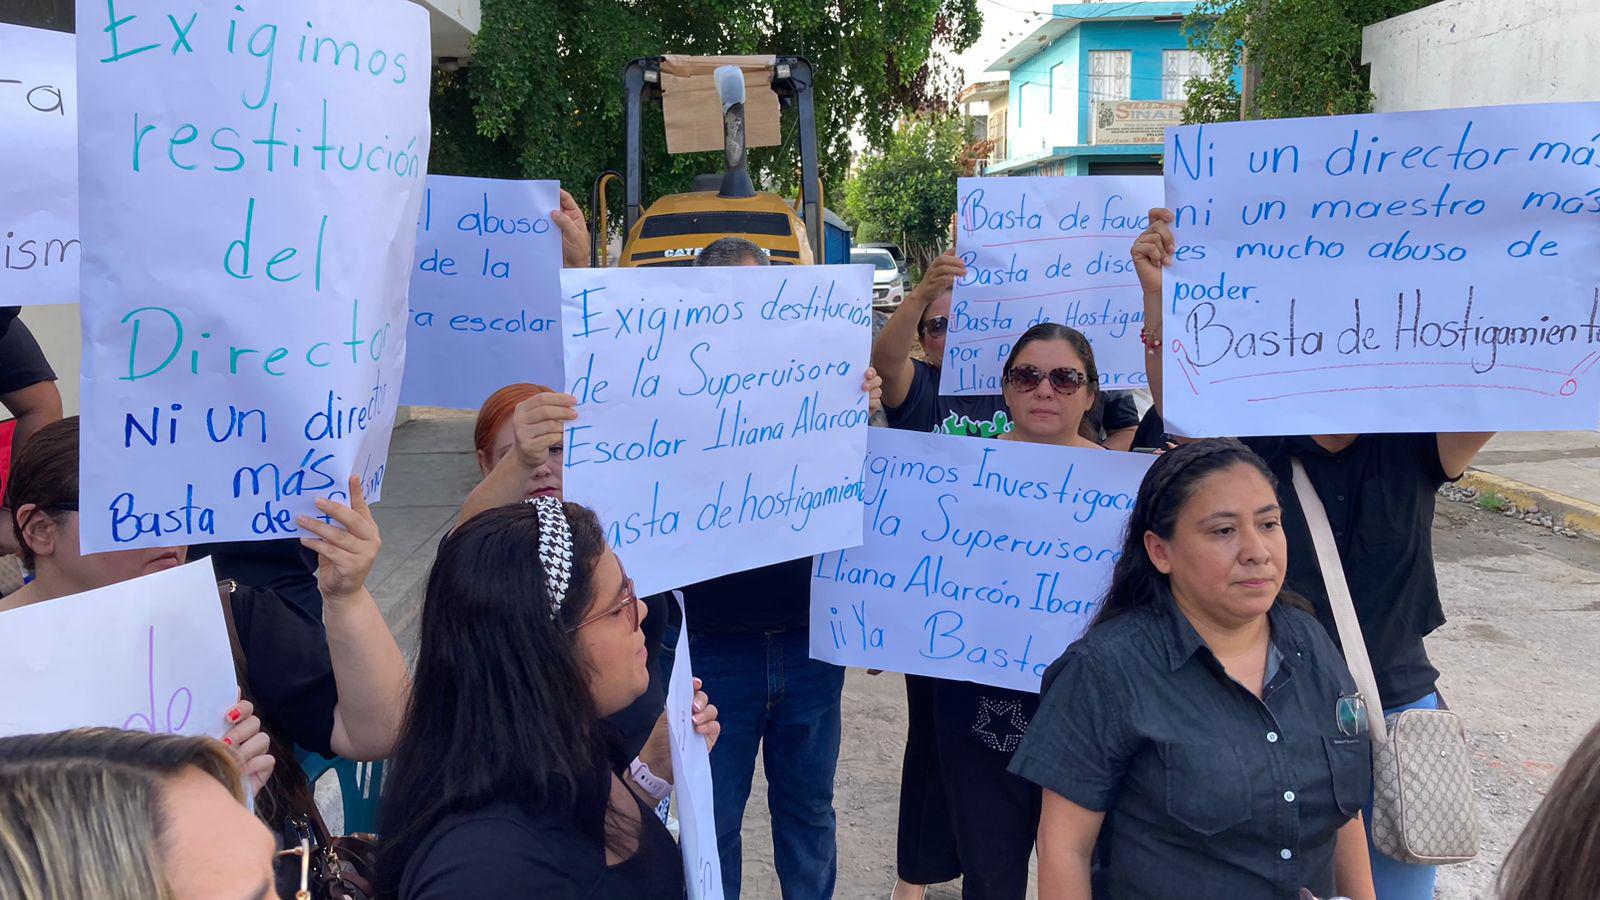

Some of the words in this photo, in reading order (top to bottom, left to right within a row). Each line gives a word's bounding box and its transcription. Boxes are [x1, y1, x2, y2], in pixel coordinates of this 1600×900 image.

[101, 0, 407, 109] Exigimos
[132, 98, 418, 179] restitución
[1173, 125, 1214, 182] Ni
[1249, 144, 1298, 175] un
[1325, 120, 1518, 176] director
[457, 192, 550, 236] abuso
[1058, 201, 1087, 231] de
[1175, 198, 1213, 228] ni
[1242, 199, 1286, 226] un
[1312, 183, 1486, 219] maestro
[223, 197, 327, 293] del
[420, 249, 458, 276] de
[482, 248, 511, 279] la
[1045, 254, 1072, 279] de
[1175, 244, 1207, 262] es
[1236, 234, 1345, 260] mucho
[1368, 230, 1468, 262] abuso
[1507, 230, 1560, 258] de
[118, 299, 391, 382] Director
[449, 309, 557, 333] escolar
[571, 286, 745, 361] Exigimos
[761, 278, 871, 327] destitución
[1337, 298, 1382, 354] de
[570, 353, 609, 406] de
[631, 357, 661, 399] la
[678, 342, 851, 409] Supervisora
[949, 346, 979, 369] por
[124, 403, 183, 448] Ni
[564, 418, 687, 469] Escolar
[702, 400, 785, 452] Iliana
[791, 391, 868, 438] Alarcón
[233, 448, 336, 502] más
[109, 484, 215, 543] Basta
[251, 501, 298, 535] de
[696, 480, 732, 532] de
[871, 488, 901, 537] la
[903, 555, 1020, 609] Alarcón
